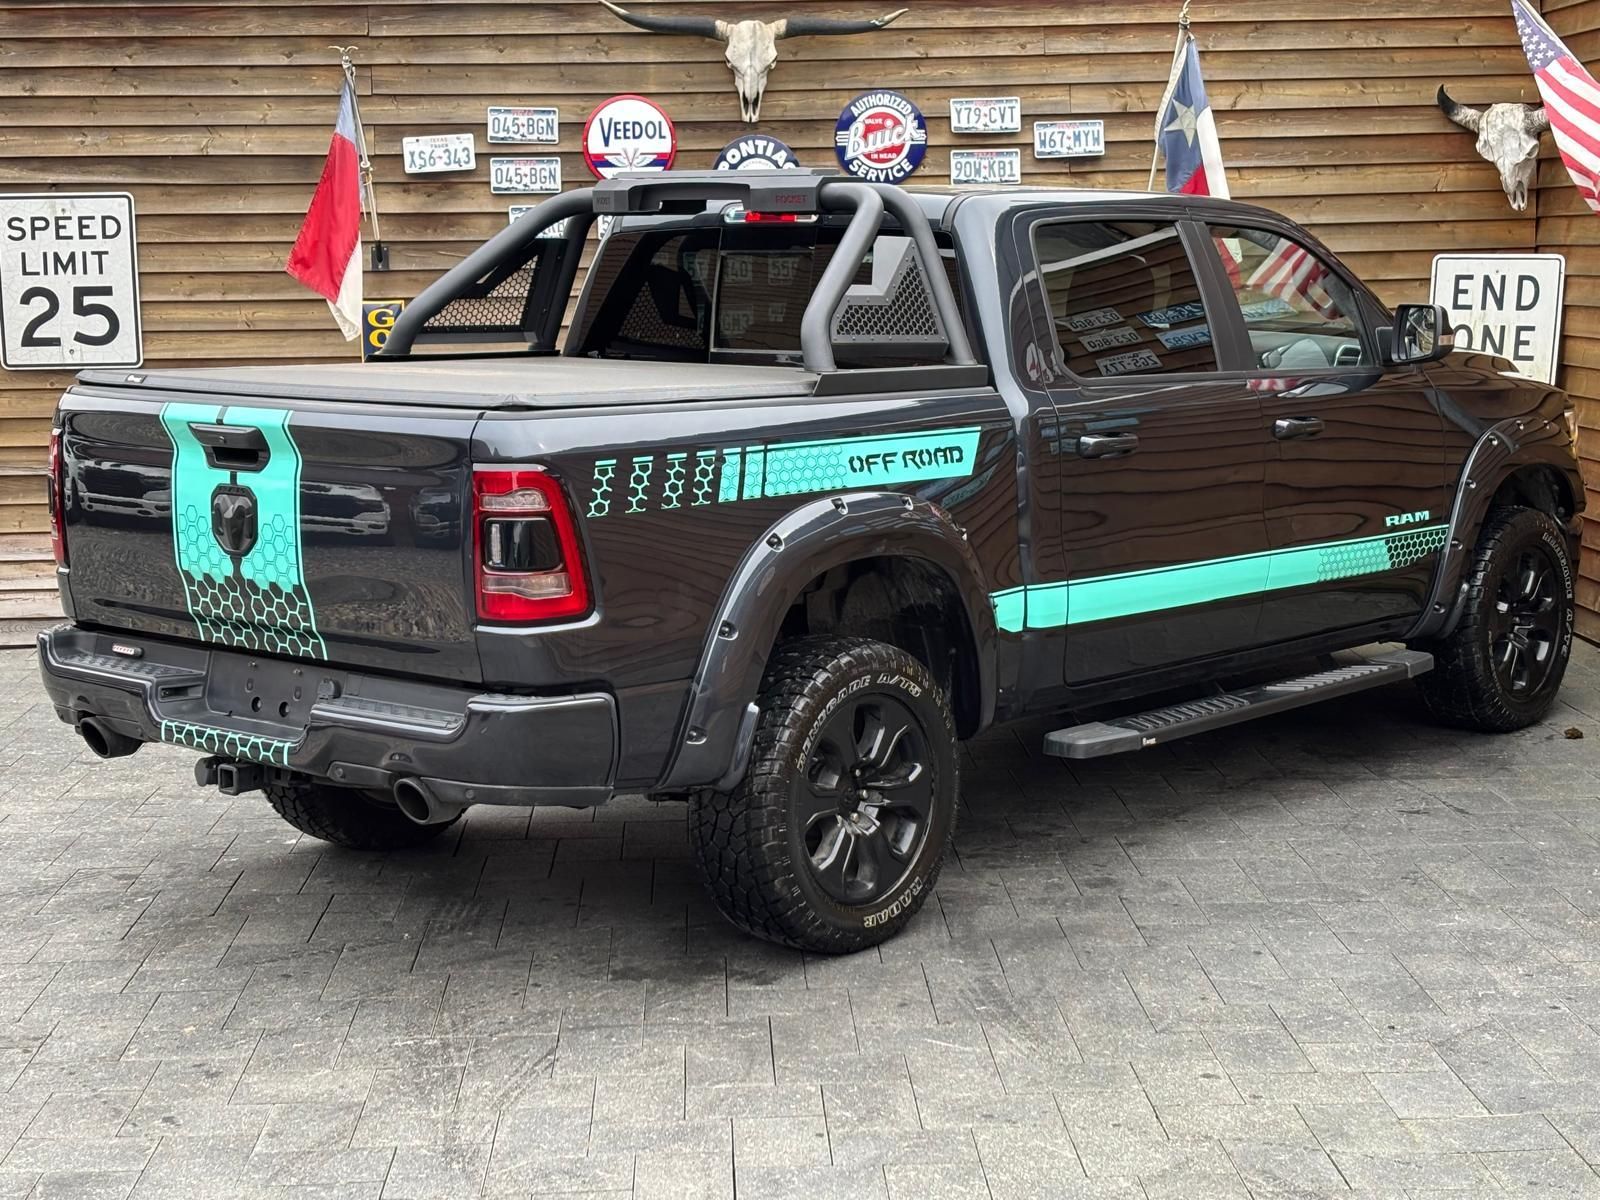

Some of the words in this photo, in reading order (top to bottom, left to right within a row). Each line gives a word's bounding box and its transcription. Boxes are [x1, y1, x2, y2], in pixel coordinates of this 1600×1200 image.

[850, 93, 912, 117] AUTHORIZED
[492, 117, 520, 134] 045
[599, 117, 667, 147] VEEDOL
[844, 112, 920, 160] Buick
[495, 168, 523, 185] 045
[849, 158, 914, 182] SERVICE
[7, 215, 121, 241] SPEED
[21, 251, 109, 275] LIMIT
[1452, 274, 1540, 311] END
[19, 286, 120, 347] 25
[848, 451, 898, 475] OFF
[901, 445, 964, 470] ROAD
[1385, 510, 1430, 527] RAM
[863, 876, 923, 928] RADAR
